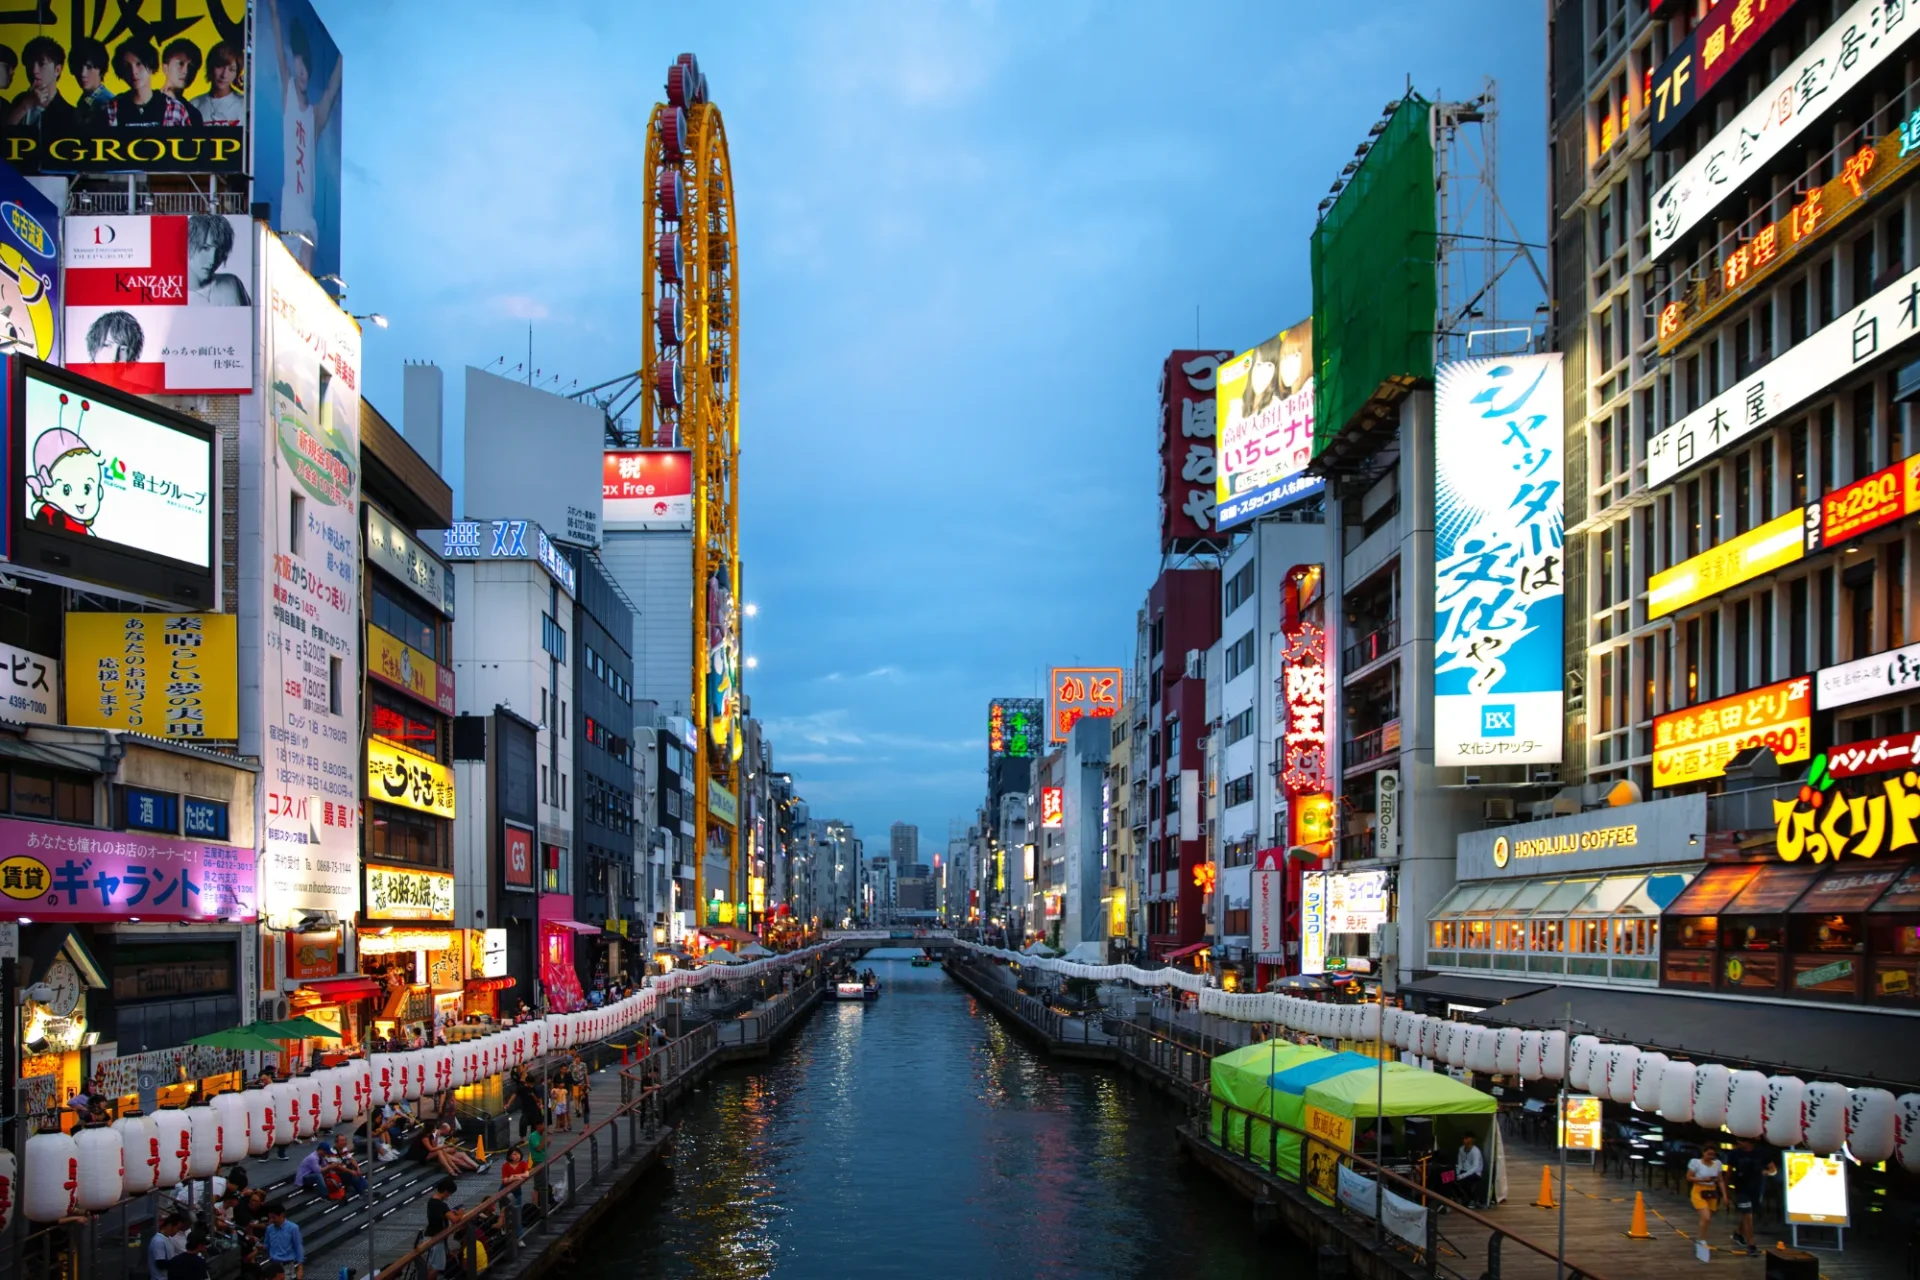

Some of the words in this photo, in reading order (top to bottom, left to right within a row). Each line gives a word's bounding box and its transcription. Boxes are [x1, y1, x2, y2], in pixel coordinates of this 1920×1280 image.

[1702, 0, 1768, 70] 個室
[1655, 54, 1691, 123] 7F
[1704, 0, 1920, 195] 完全個室居酒
[49, 138, 241, 161] GROUP
[12, 209, 44, 253] 中古流通
[1726, 222, 1776, 289] 料理
[115, 272, 183, 292] KANZAKI
[141, 286, 183, 303] RUKA
[161, 345, 235, 357] めっちゃ面白いを
[213, 358, 246, 370] 仕事に。
[1225, 385, 1315, 446] 高収入お仕事情
[1677, 381, 1767, 467] 白木屋
[297, 428, 349, 488] 新規会員募集
[1653, 433, 1670, 457] 4F
[618, 457, 641, 479] 税
[132, 470, 207, 506] 富士グループ
[603, 485, 618, 495] ax
[623, 482, 655, 495] Free
[1837, 473, 1896, 518] ¥280
[444, 520, 527, 556] 無双
[97, 658, 120, 718] 応援します
[125, 618, 146, 727] あなたのお店づくり
[164, 616, 205, 738] 素晴らしい夢の実現
[9, 695, 47, 715] 4396-7000
[1059, 676, 1115, 703] かに
[1788, 679, 1809, 701] 2F
[1280, 621, 1326, 792] 大阪王将
[1485, 713, 1512, 729] BX
[1655, 690, 1789, 749] 豊後高田どり
[1457, 740, 1543, 757] 文化シャッター
[378, 755, 434, 807] うなぎ
[140, 796, 154, 824] 酒
[186, 804, 215, 832] たばこ
[268, 792, 307, 821] コスパ
[323, 801, 354, 829] 最高!
[1381, 793, 1392, 825] ZERO
[27, 832, 198, 863] あなたも憧れのお店のオーナーに!
[511, 841, 526, 870] G3
[1514, 833, 1577, 858] HONOLULU
[1580, 825, 1638, 848] COFFEE
[2, 866, 45, 890] 賃貸
[53, 858, 200, 907] ギャラント
[387, 873, 431, 907] お好み焼
